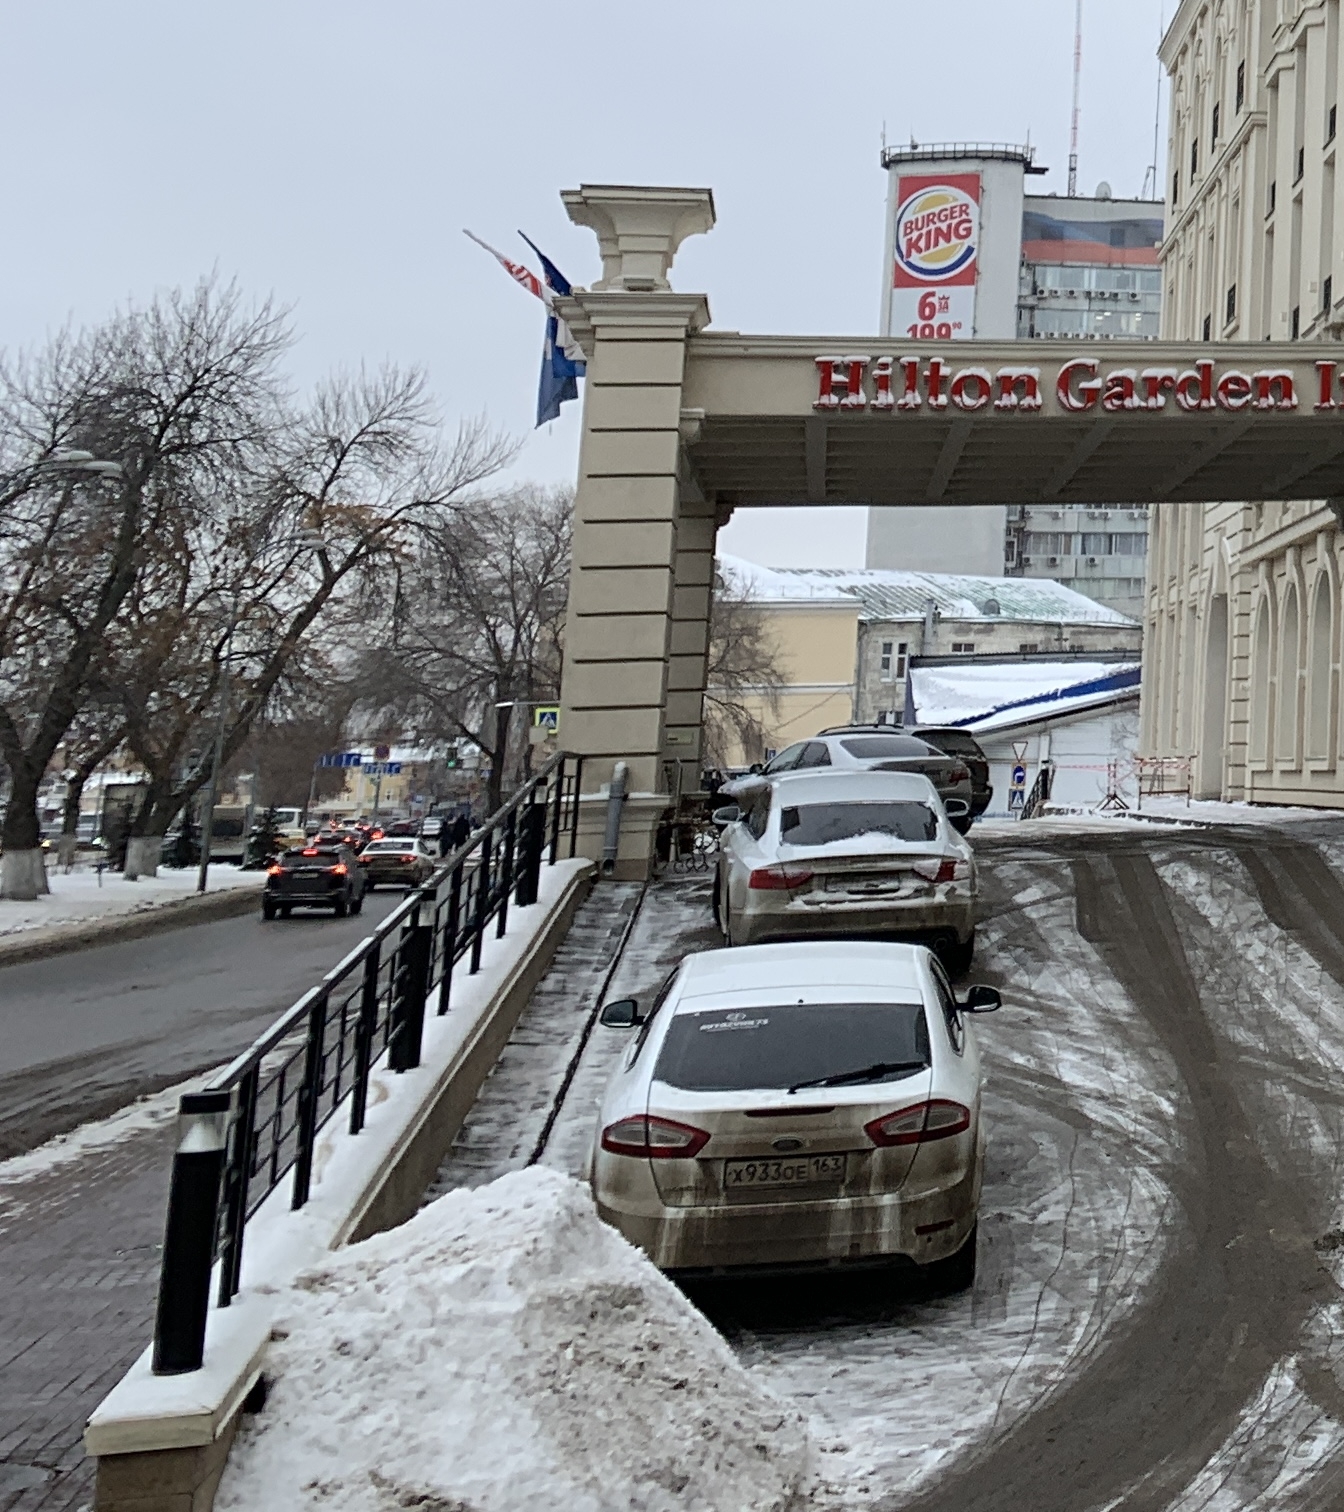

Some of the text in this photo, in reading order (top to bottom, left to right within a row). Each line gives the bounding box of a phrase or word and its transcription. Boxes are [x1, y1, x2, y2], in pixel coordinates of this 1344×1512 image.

[903, 203, 970, 238] BURGER
[905, 218, 973, 261] KING
[917, 291, 936, 321] 6
[812, 356, 1042, 411] Hilton
[1056, 358, 1299, 412] Garden
